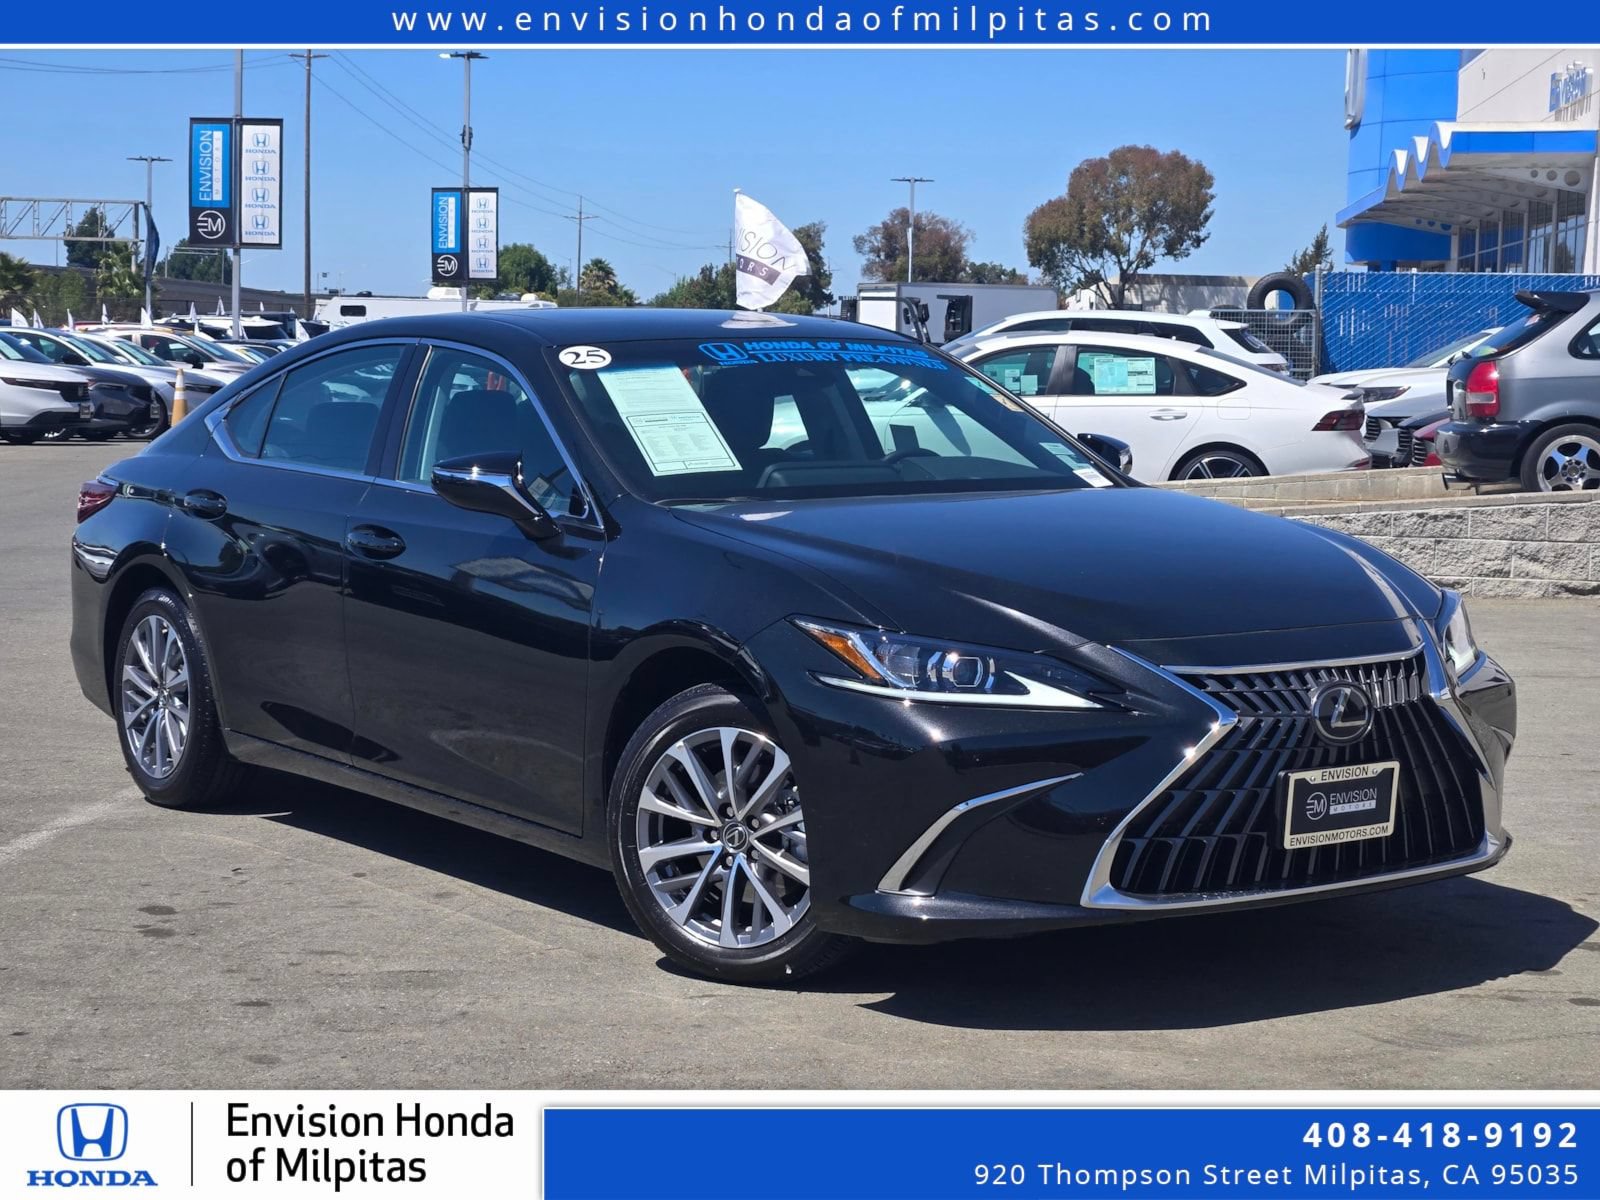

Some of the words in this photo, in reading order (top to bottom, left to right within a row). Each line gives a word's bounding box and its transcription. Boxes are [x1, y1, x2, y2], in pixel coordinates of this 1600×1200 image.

[199, 130, 212, 201] ENVISION
[438, 196, 448, 249] ENVISION
[744, 341, 815, 350] HONDA
[817, 342, 841, 350] OF
[564, 350, 607, 365] 25
[756, 353, 839, 362] LUXURY
[1321, 765, 1369, 781] ENVISION
[1329, 788, 1377, 805] ENVISION
[1289, 825, 1389, 847] ENVISIONMOTORS.COM
